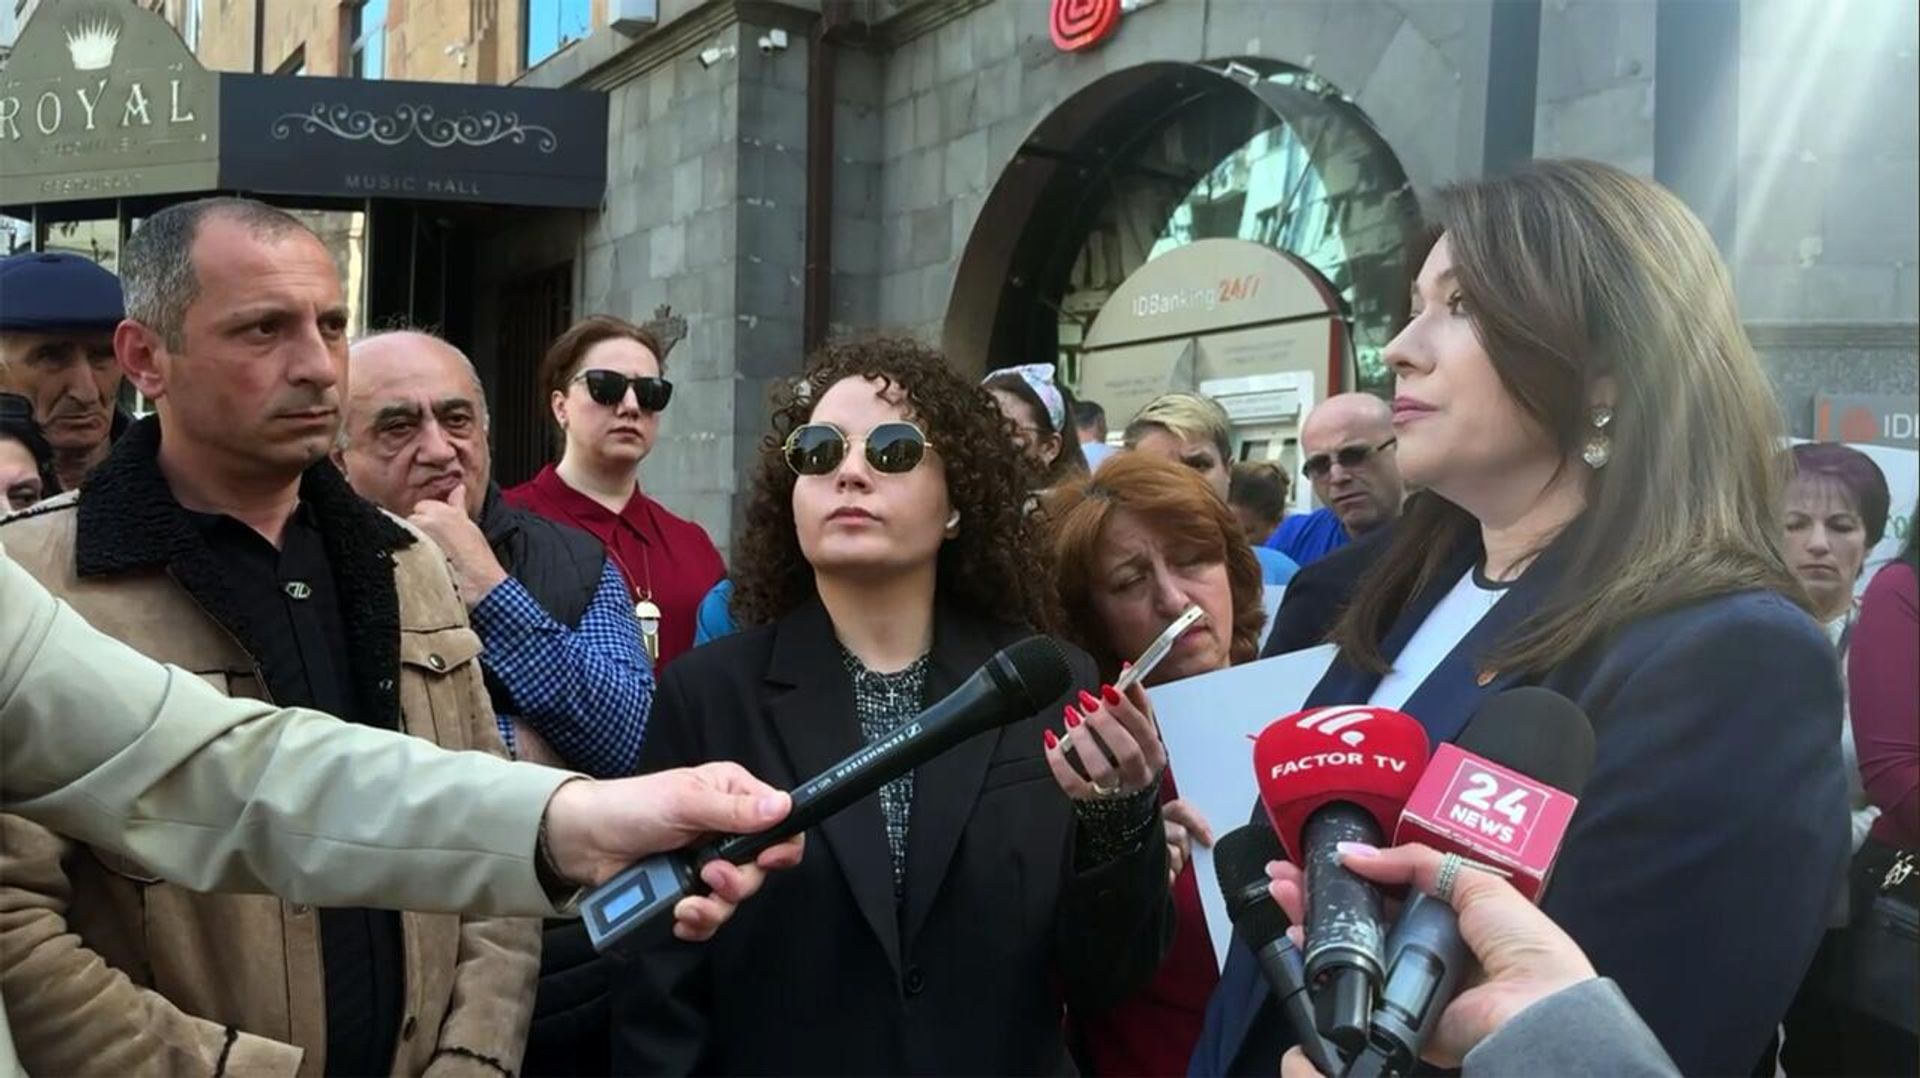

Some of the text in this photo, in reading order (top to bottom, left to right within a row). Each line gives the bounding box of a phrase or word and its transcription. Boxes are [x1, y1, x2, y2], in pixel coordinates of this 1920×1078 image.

[0, 79, 195, 139] ROYAL
[344, 173, 481, 197] MUSIC HALL
[1131, 289, 1216, 317] IDBanking
[1884, 413, 1919, 438] ID
[1271, 752, 1406, 780] FACTOR TV
[1458, 772, 1529, 825] 24
[1449, 804, 1516, 844] NEWS
